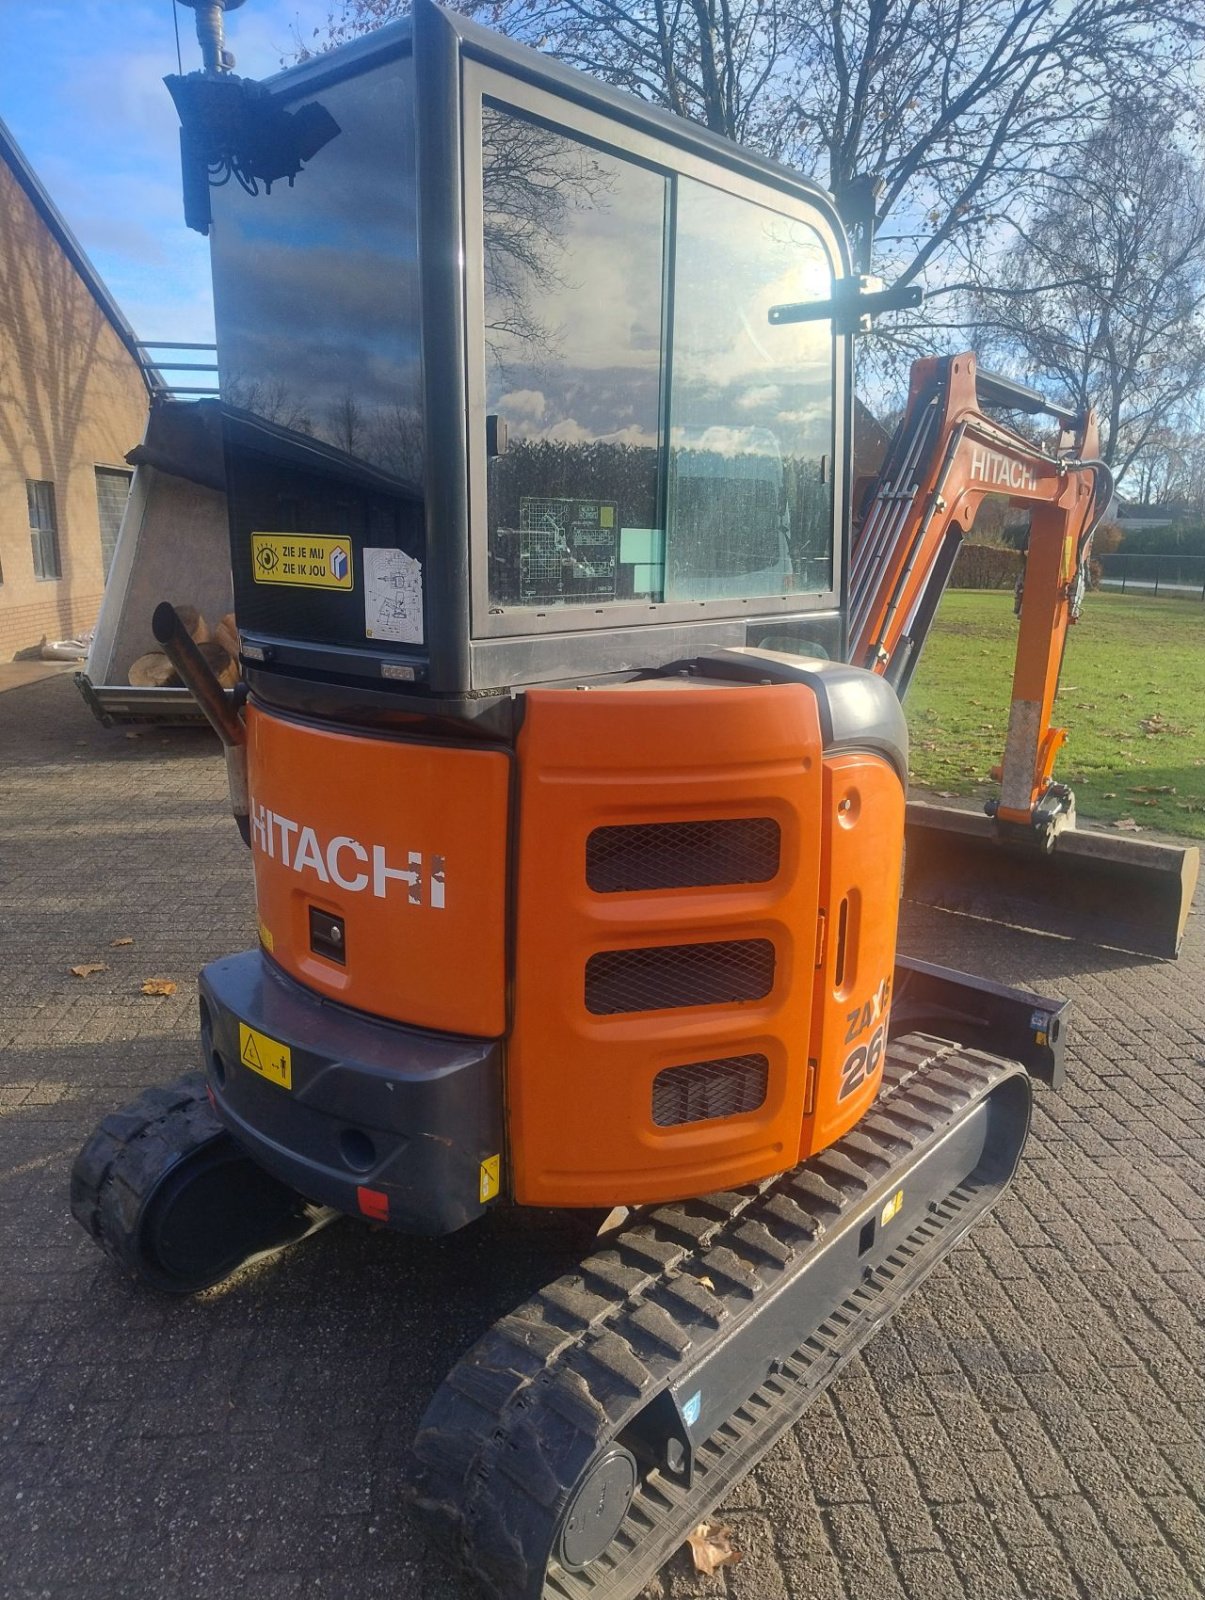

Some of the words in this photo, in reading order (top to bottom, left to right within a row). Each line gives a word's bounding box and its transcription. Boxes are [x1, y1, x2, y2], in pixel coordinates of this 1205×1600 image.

[970, 448, 1037, 491] HITACHI
[282, 546, 295, 557] ZIE
[298, 547, 306, 558] JE
[309, 548, 324, 559] MIJ
[283, 563, 295, 574] ZIE
[298, 565, 307, 575] IK
[309, 565, 326, 577] JOU
[251, 796, 445, 909] HITACHI
